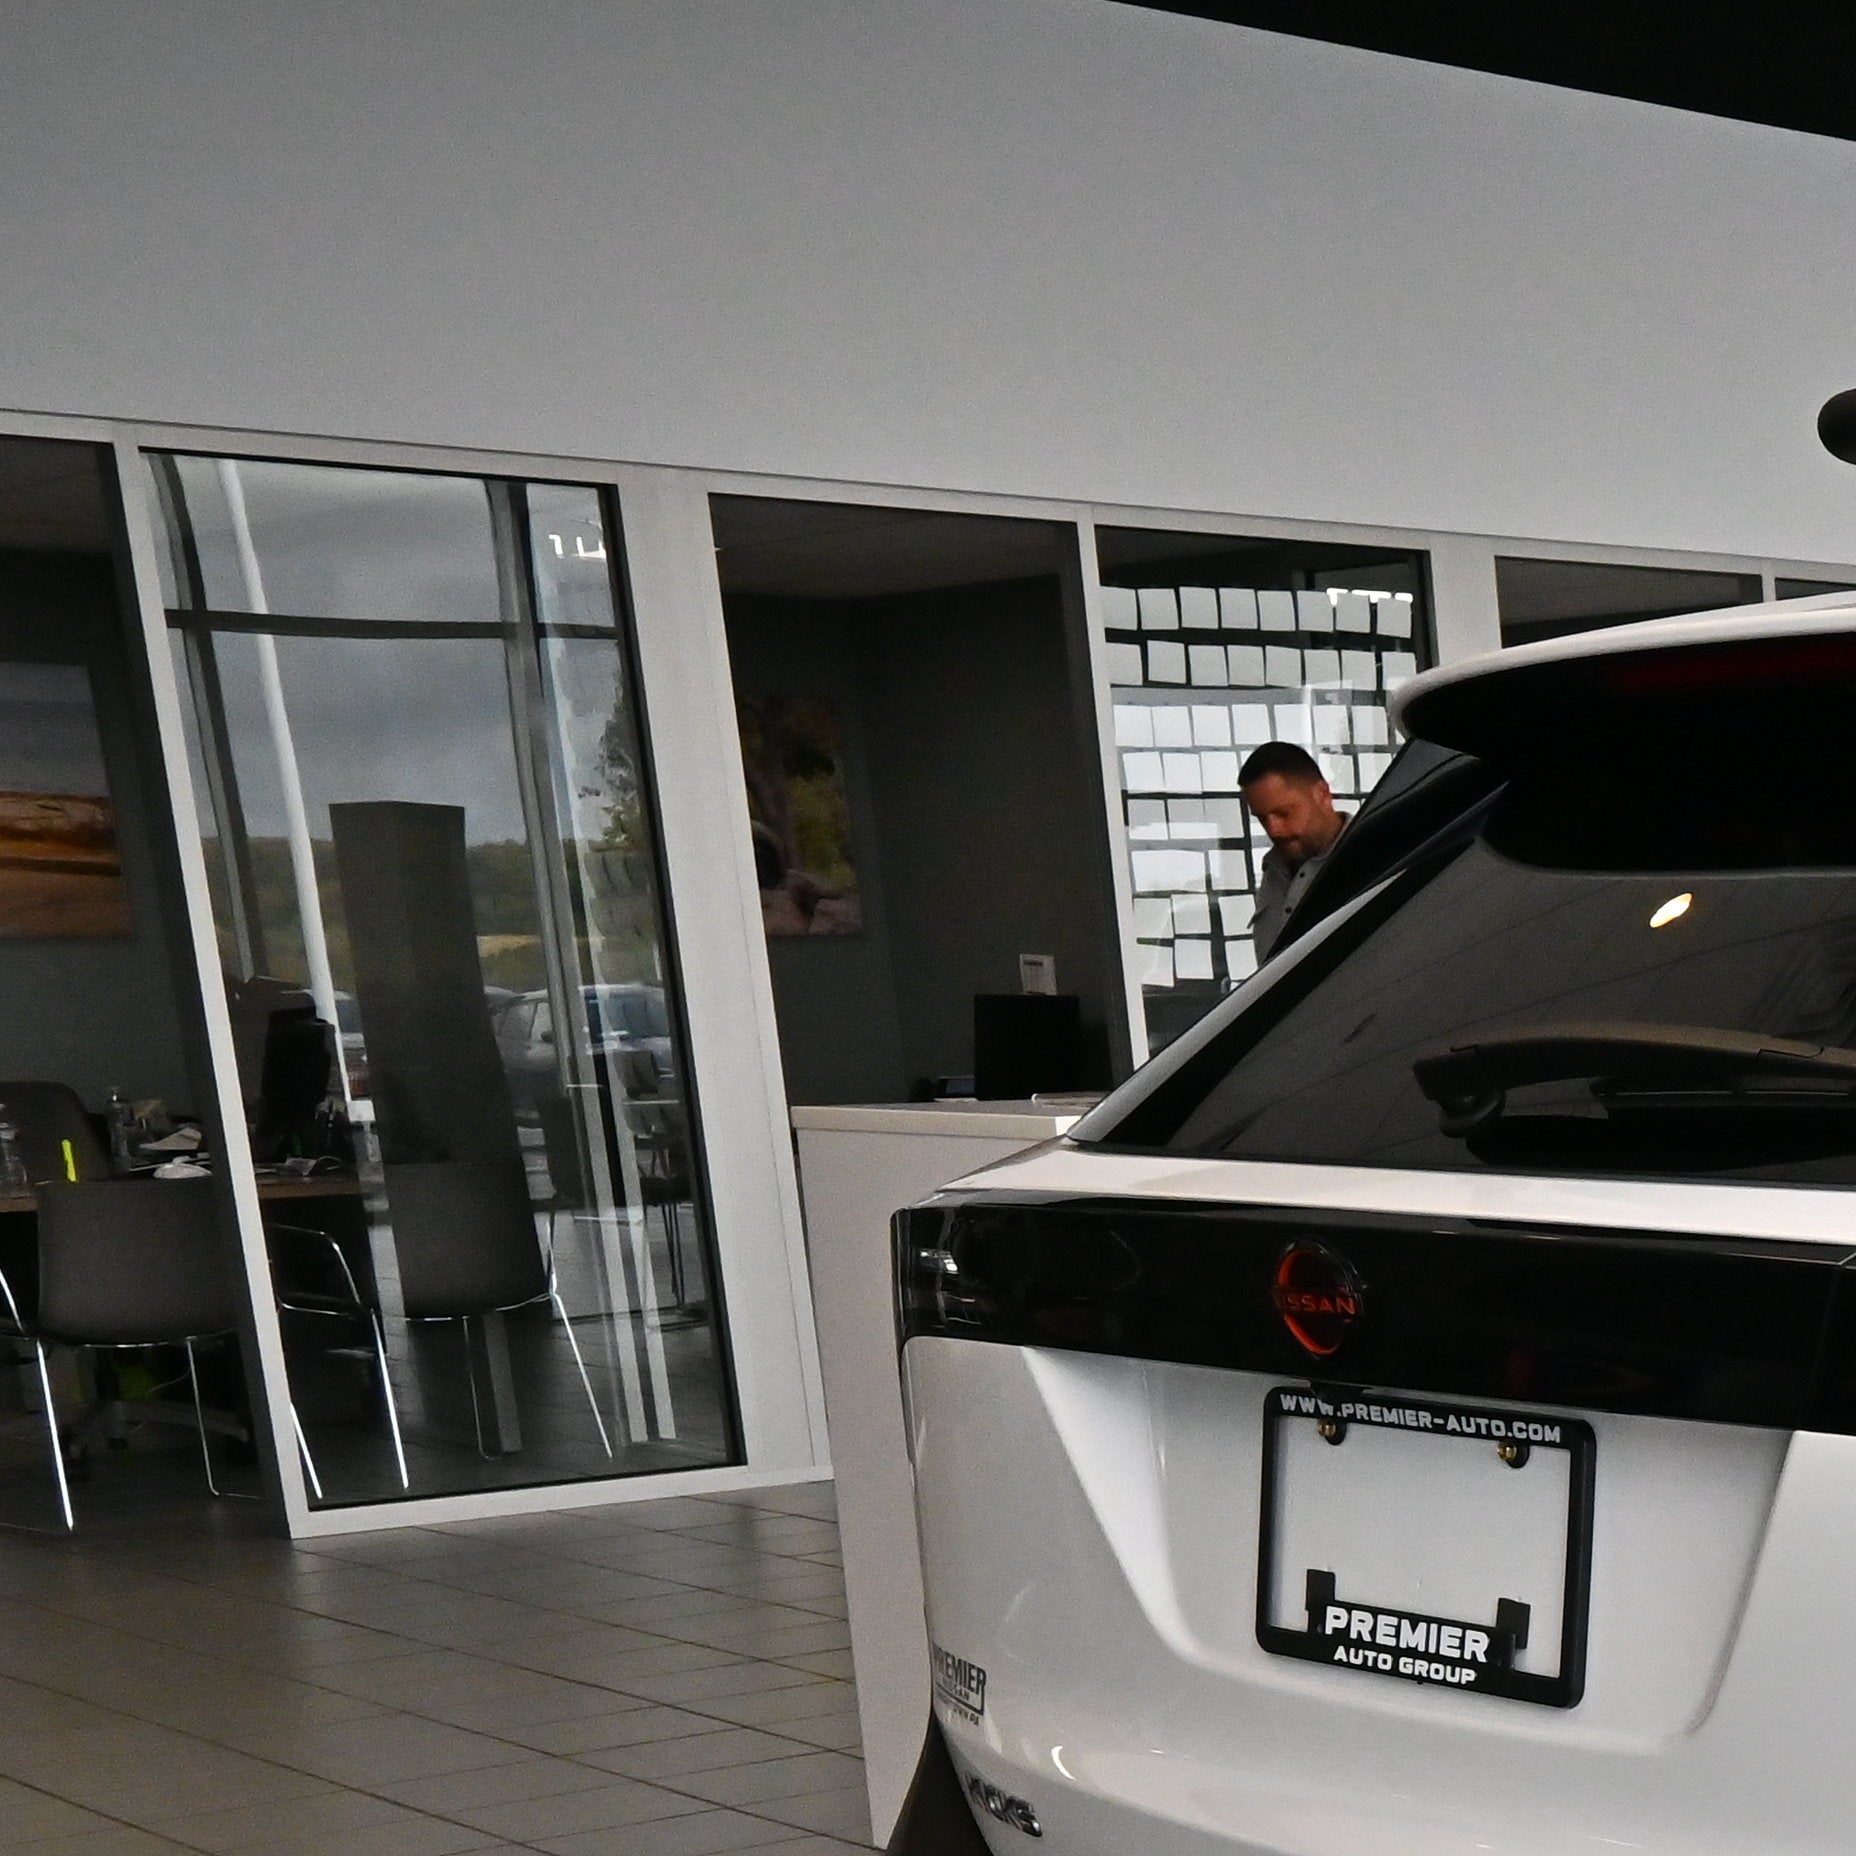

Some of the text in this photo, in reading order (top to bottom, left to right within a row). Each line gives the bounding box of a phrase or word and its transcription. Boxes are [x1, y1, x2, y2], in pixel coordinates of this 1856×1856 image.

[1278, 1392, 1562, 1445] WWW.PREMIER-AUTO.COM
[1324, 1604, 1491, 1664] PREMIER
[1333, 1644, 1477, 1686] AUTO GROUP
